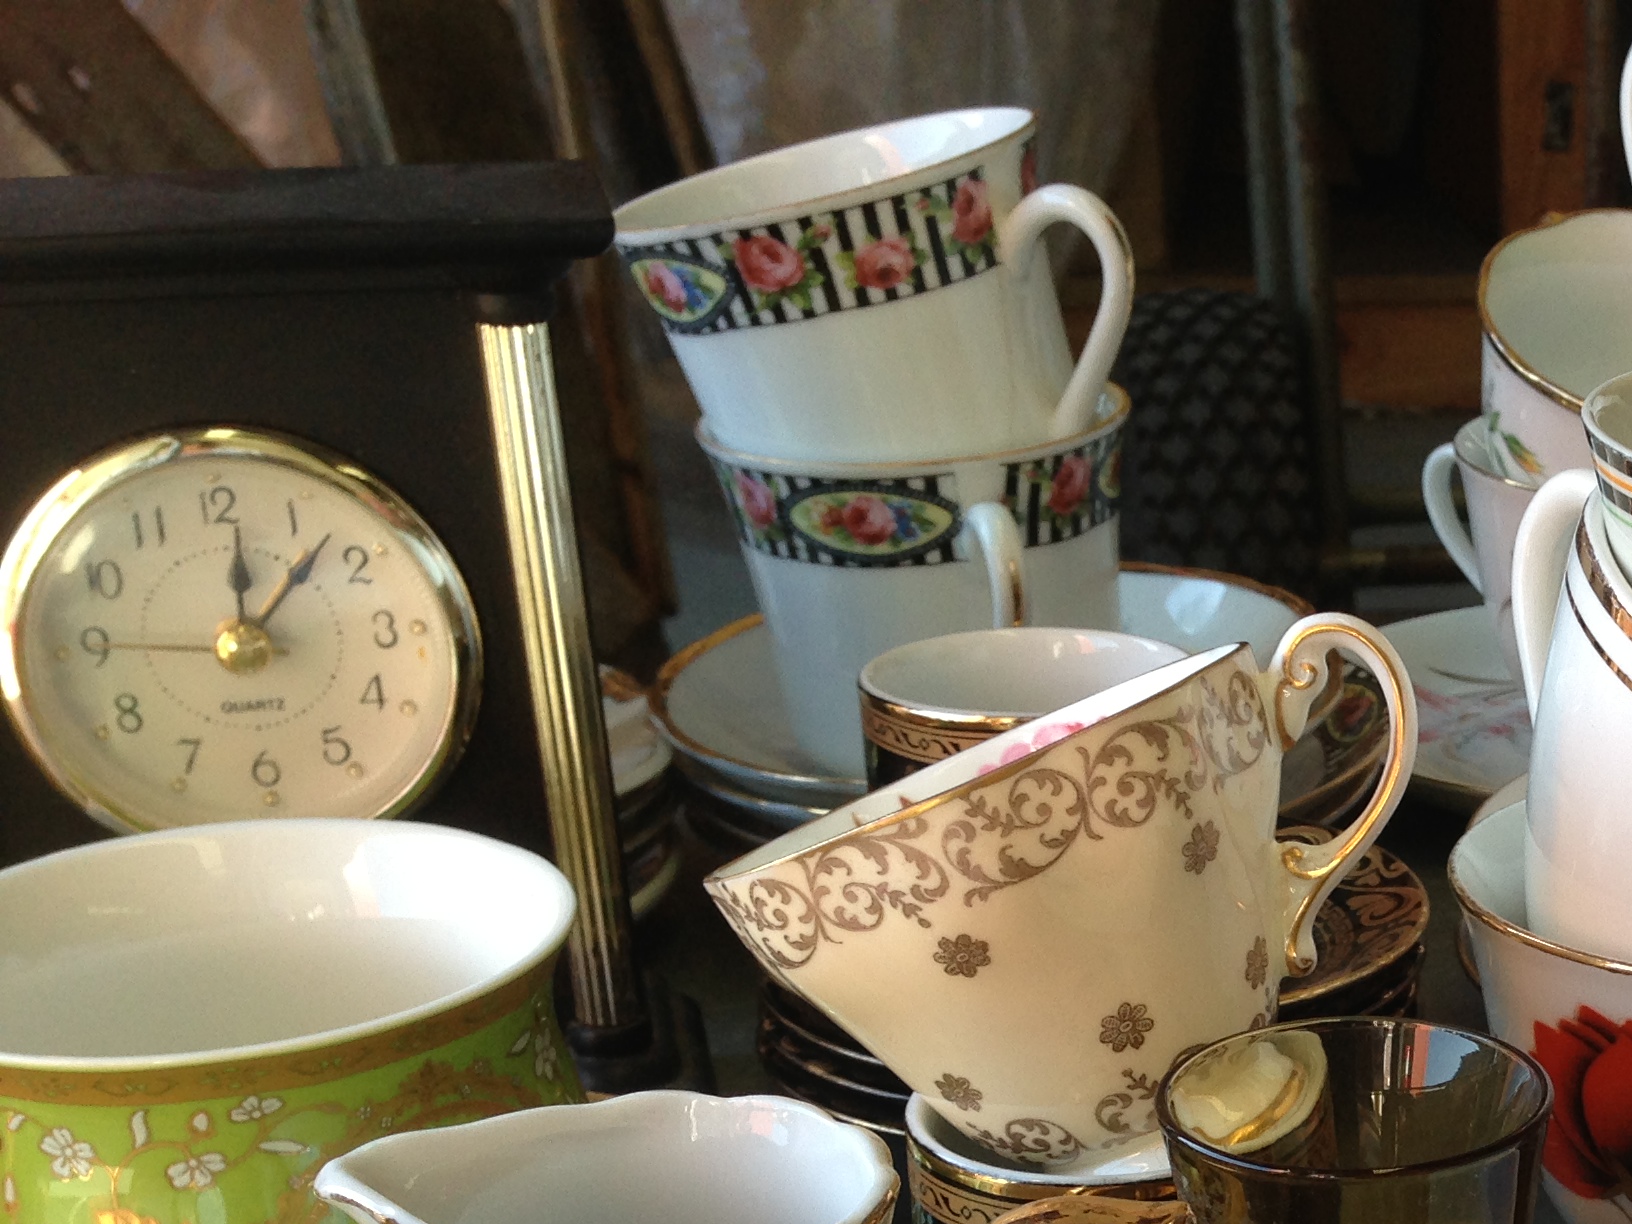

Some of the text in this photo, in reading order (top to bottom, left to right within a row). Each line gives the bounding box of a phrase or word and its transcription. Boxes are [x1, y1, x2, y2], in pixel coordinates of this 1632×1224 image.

[200, 486, 240, 525] 12
[287, 500, 298, 537] 1
[132, 506, 167, 549] 11
[85, 558, 125, 600] 10
[342, 545, 373, 585] 2
[80, 625, 111, 668] 9
[371, 609, 399, 649] 3
[220, 697, 286, 714] QUARTZ
[359, 673, 385, 713] 4
[114, 693, 143, 734] 8
[177, 736, 202, 774] 7
[321, 724, 351, 766] 5
[251, 750, 281, 787] 6
